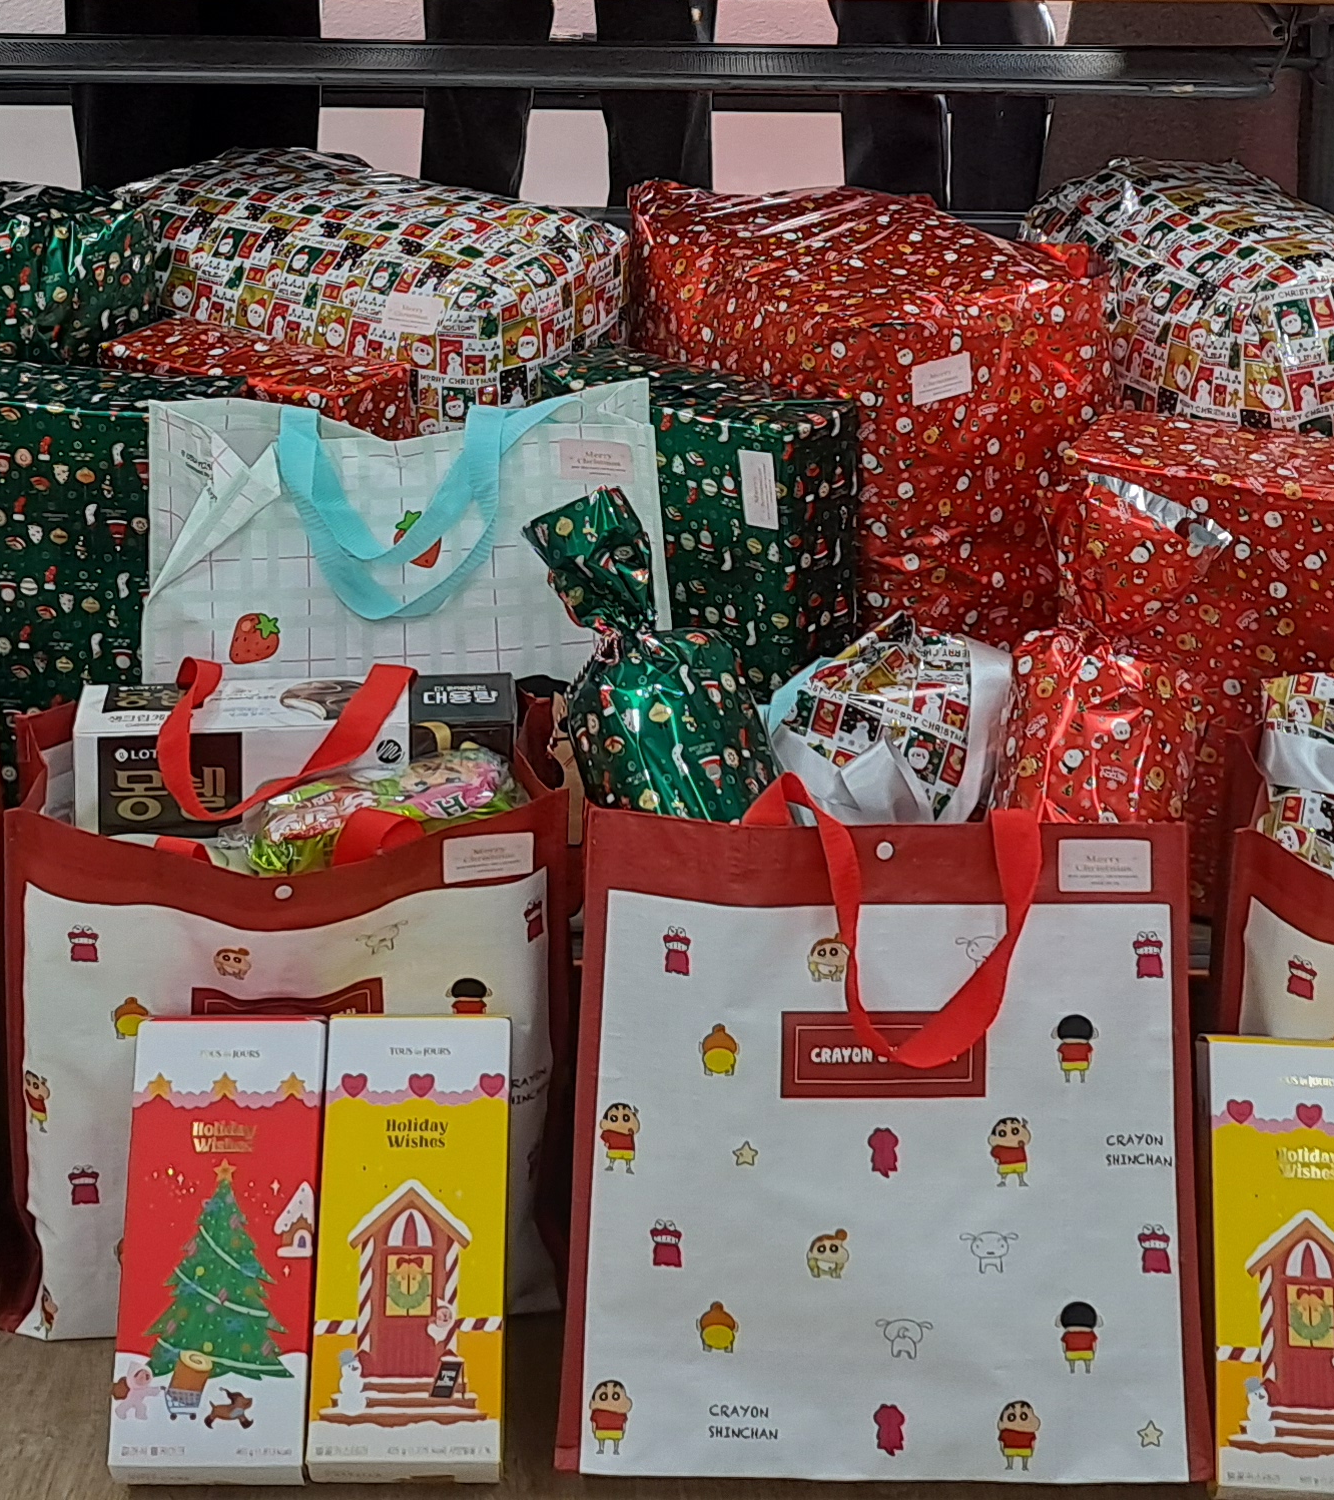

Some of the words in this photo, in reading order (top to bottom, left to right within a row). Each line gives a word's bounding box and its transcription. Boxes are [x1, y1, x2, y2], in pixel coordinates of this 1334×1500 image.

[921, 719, 968, 746] CHRISTMA
[131, 749, 157, 760] LOT
[810, 1046, 873, 1063] CRAYON
[192, 1120, 256, 1140] Holiday
[385, 1118, 449, 1135] Holiday
[193, 1137, 254, 1153] Wishes
[387, 1134, 447, 1149] Wishes
[1106, 1133, 1164, 1146] CRAYON
[1105, 1153, 1173, 1168] SHINCHAN
[708, 1403, 769, 1419] CRAYON
[708, 1425, 779, 1440] SHINCHAN
